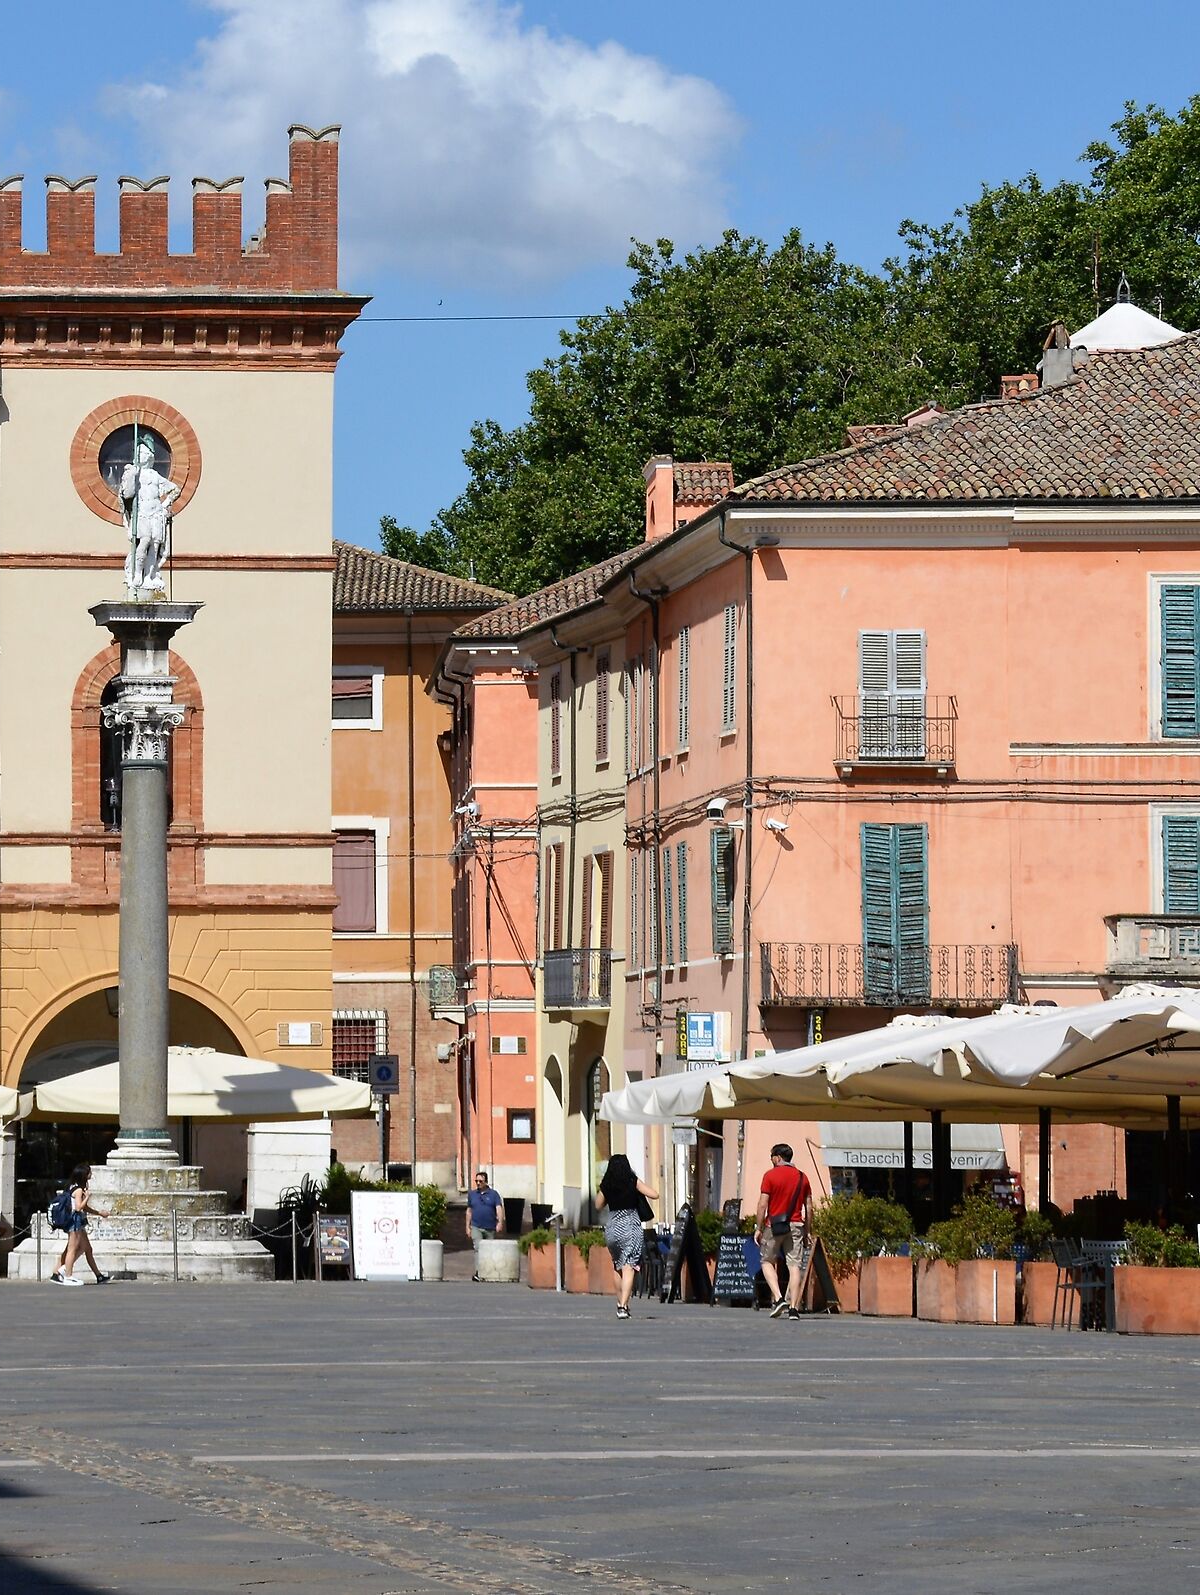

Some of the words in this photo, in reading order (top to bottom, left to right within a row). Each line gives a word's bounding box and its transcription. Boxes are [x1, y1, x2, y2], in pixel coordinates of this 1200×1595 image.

[690, 1015, 711, 1039] T
[843, 1151, 904, 1165] Tabacchi
[922, 1152, 984, 1167] Svenir
